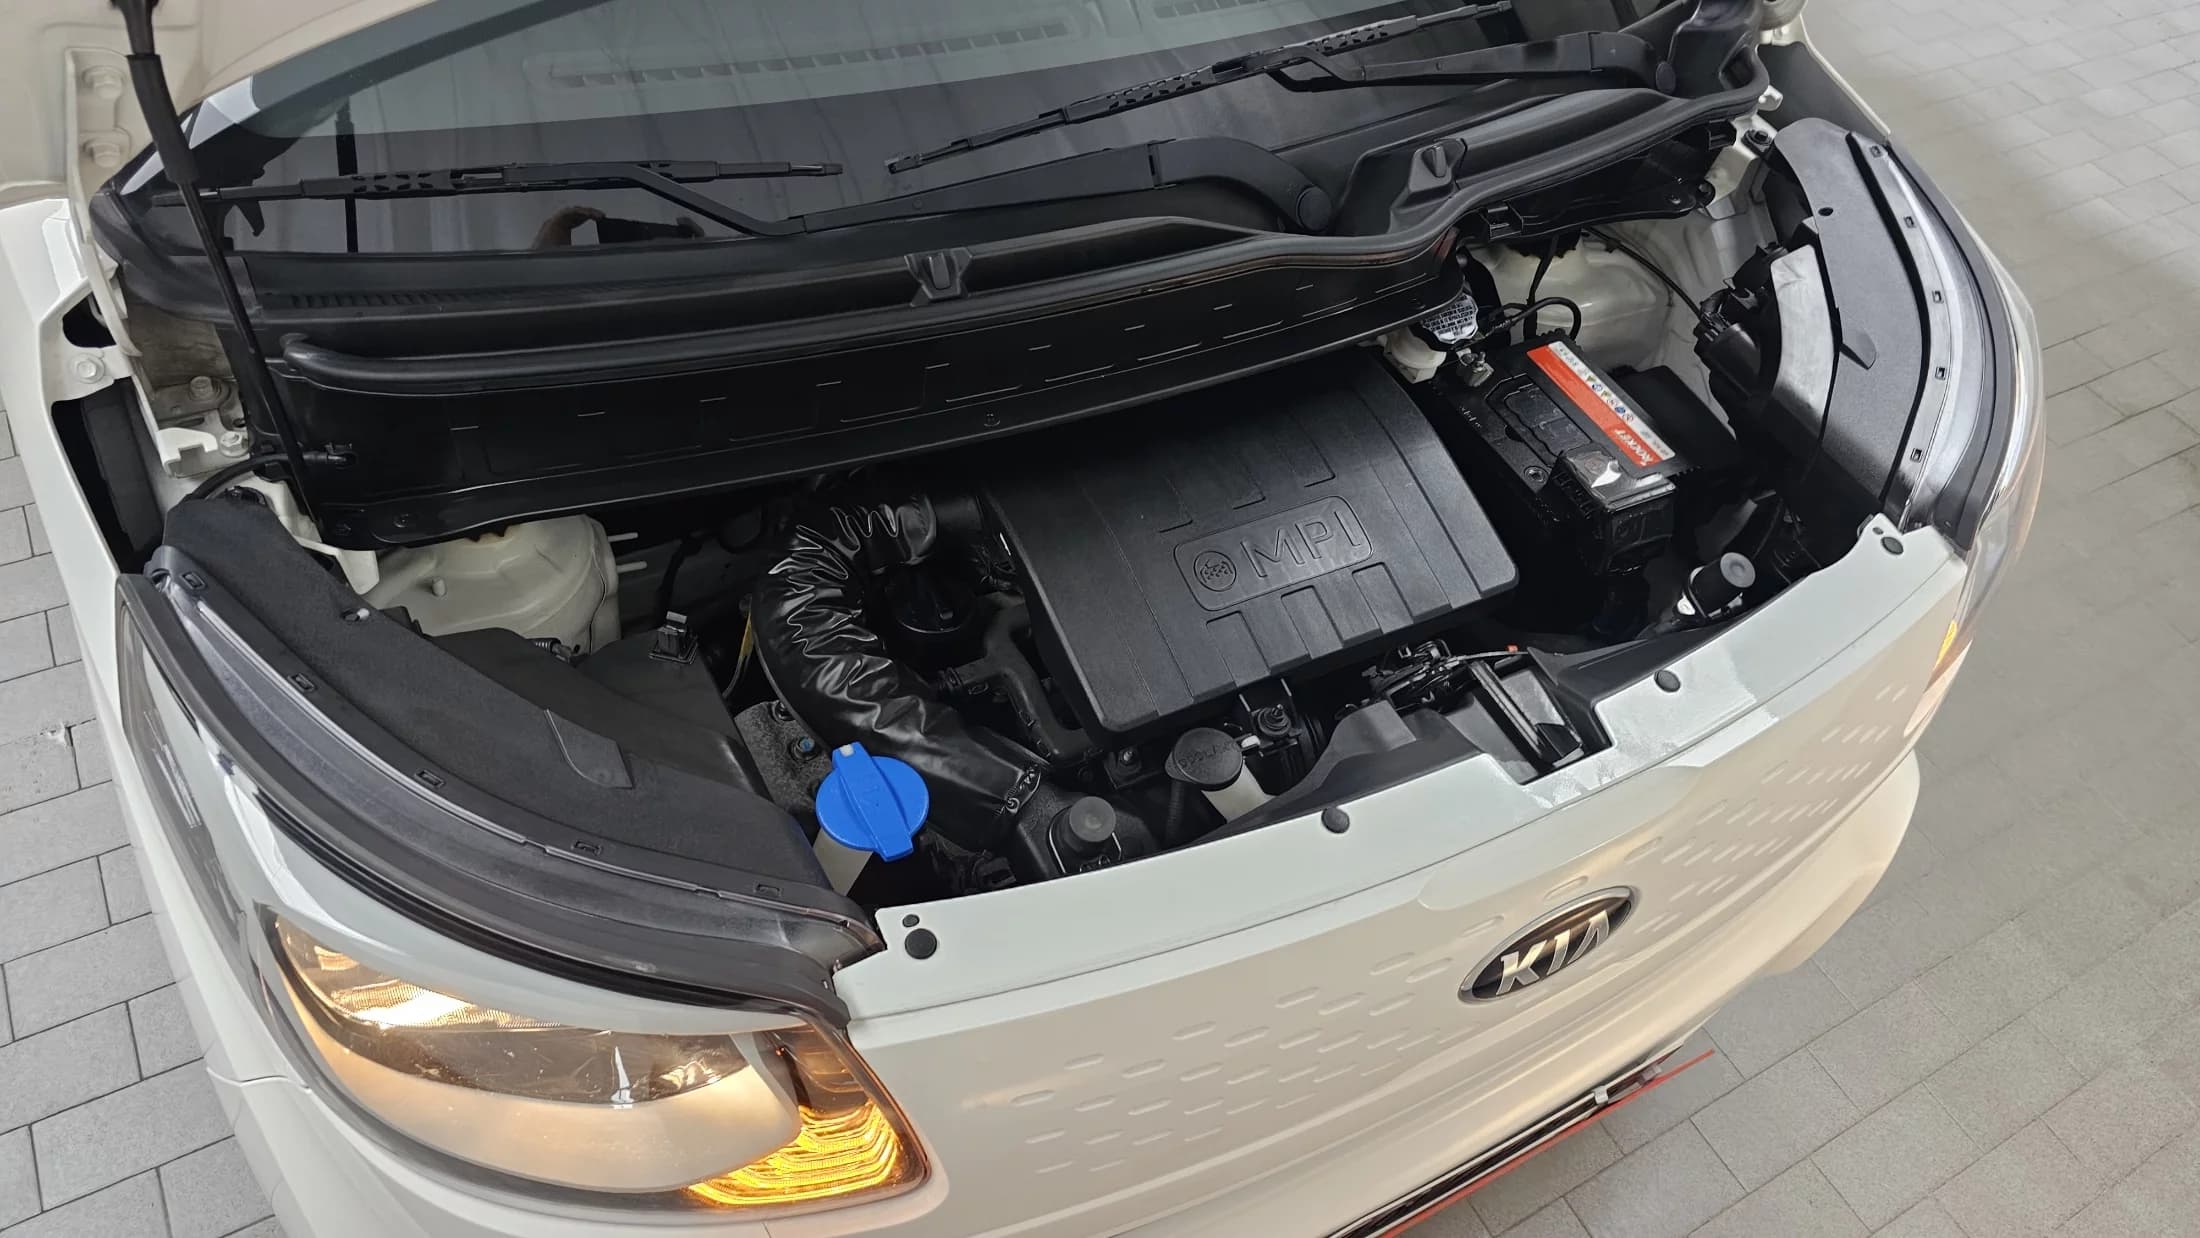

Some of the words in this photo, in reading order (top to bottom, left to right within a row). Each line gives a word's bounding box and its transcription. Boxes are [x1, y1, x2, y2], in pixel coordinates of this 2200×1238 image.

[1614, 428, 1654, 466] ROCKET
[1240, 510, 1361, 578] MPI
[1496, 910, 1609, 995] KIA
